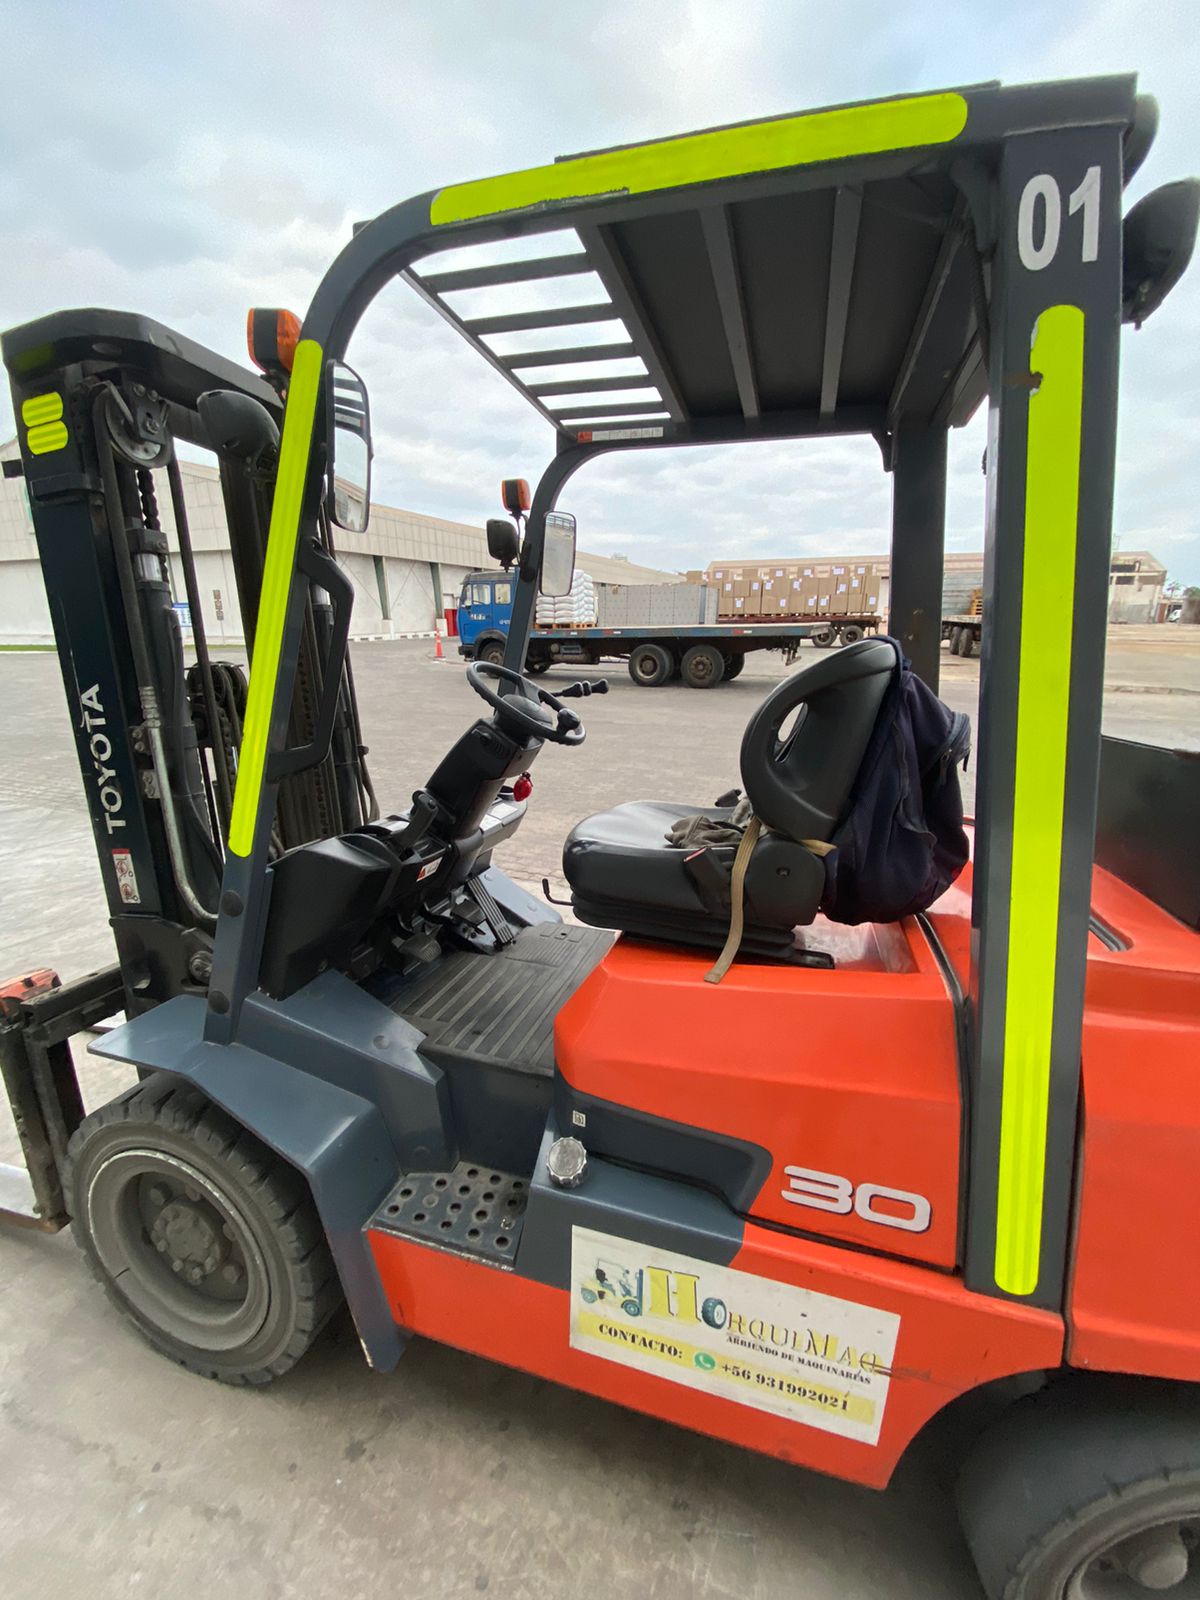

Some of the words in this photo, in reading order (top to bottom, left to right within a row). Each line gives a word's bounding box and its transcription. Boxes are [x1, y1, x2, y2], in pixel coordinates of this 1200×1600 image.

[1018, 166, 1101, 271] 01
[80, 683, 126, 835] TOYOTA
[781, 1165, 932, 1233] 30
[598, 1323, 683, 1358] CONTACTO:
[722, 1363, 751, 1381] +56
[756, 1371, 849, 1410] 931992021
[726, 1335, 779, 1357] ARRIENDO
[781, 1350, 795, 1362] DE
